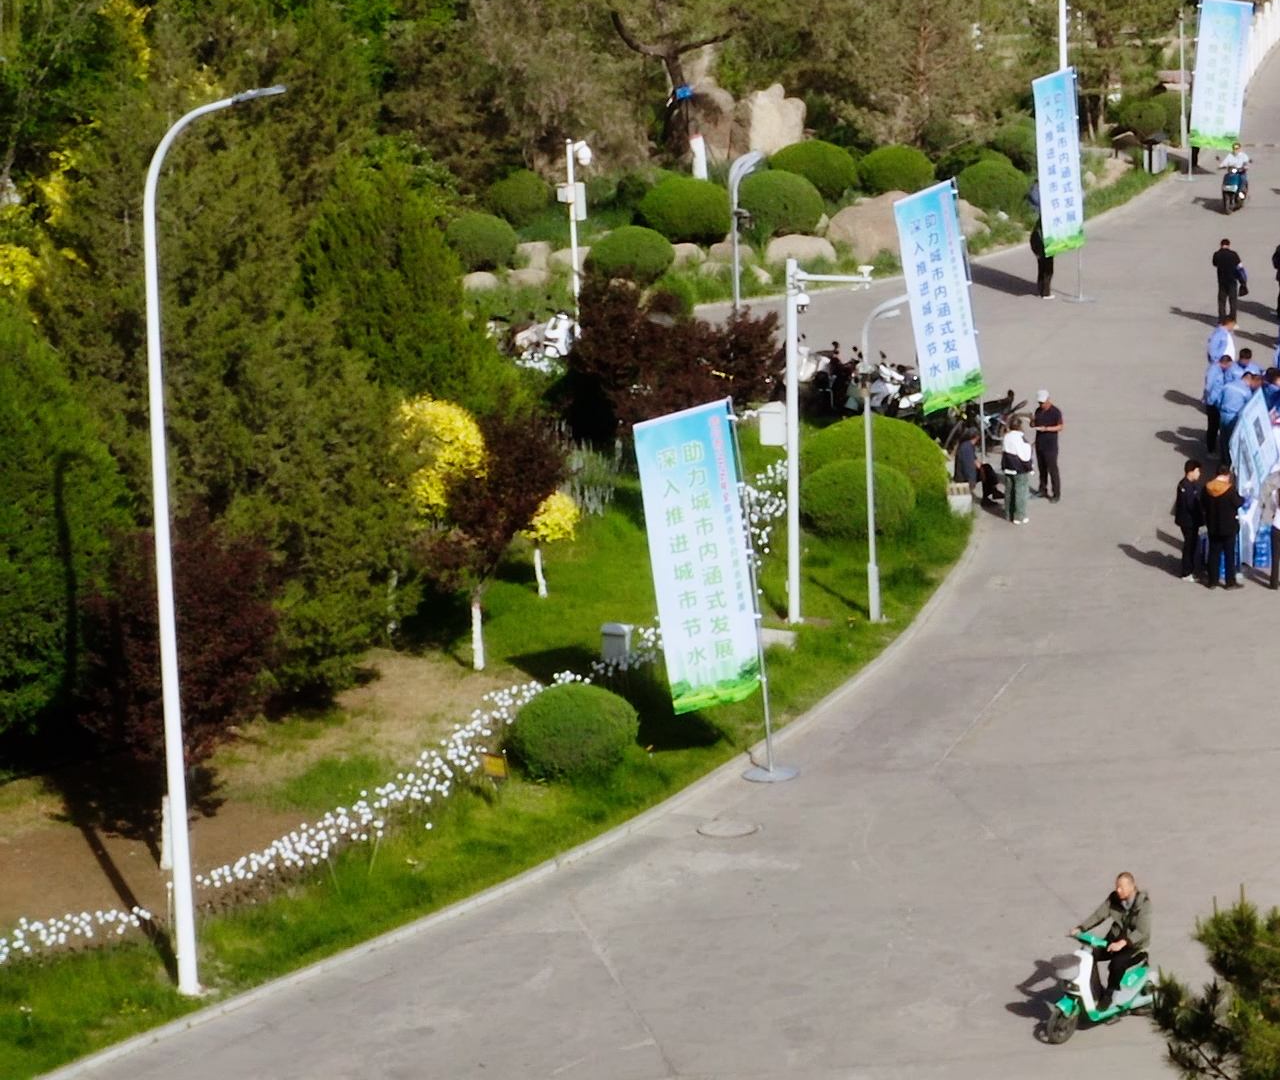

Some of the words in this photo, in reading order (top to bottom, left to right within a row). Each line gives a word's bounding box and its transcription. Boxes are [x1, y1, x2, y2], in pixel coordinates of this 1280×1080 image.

[656, 448, 708, 667] 深入推进城市节水
[682, 440, 735, 660] 助力城市内涵式发展
